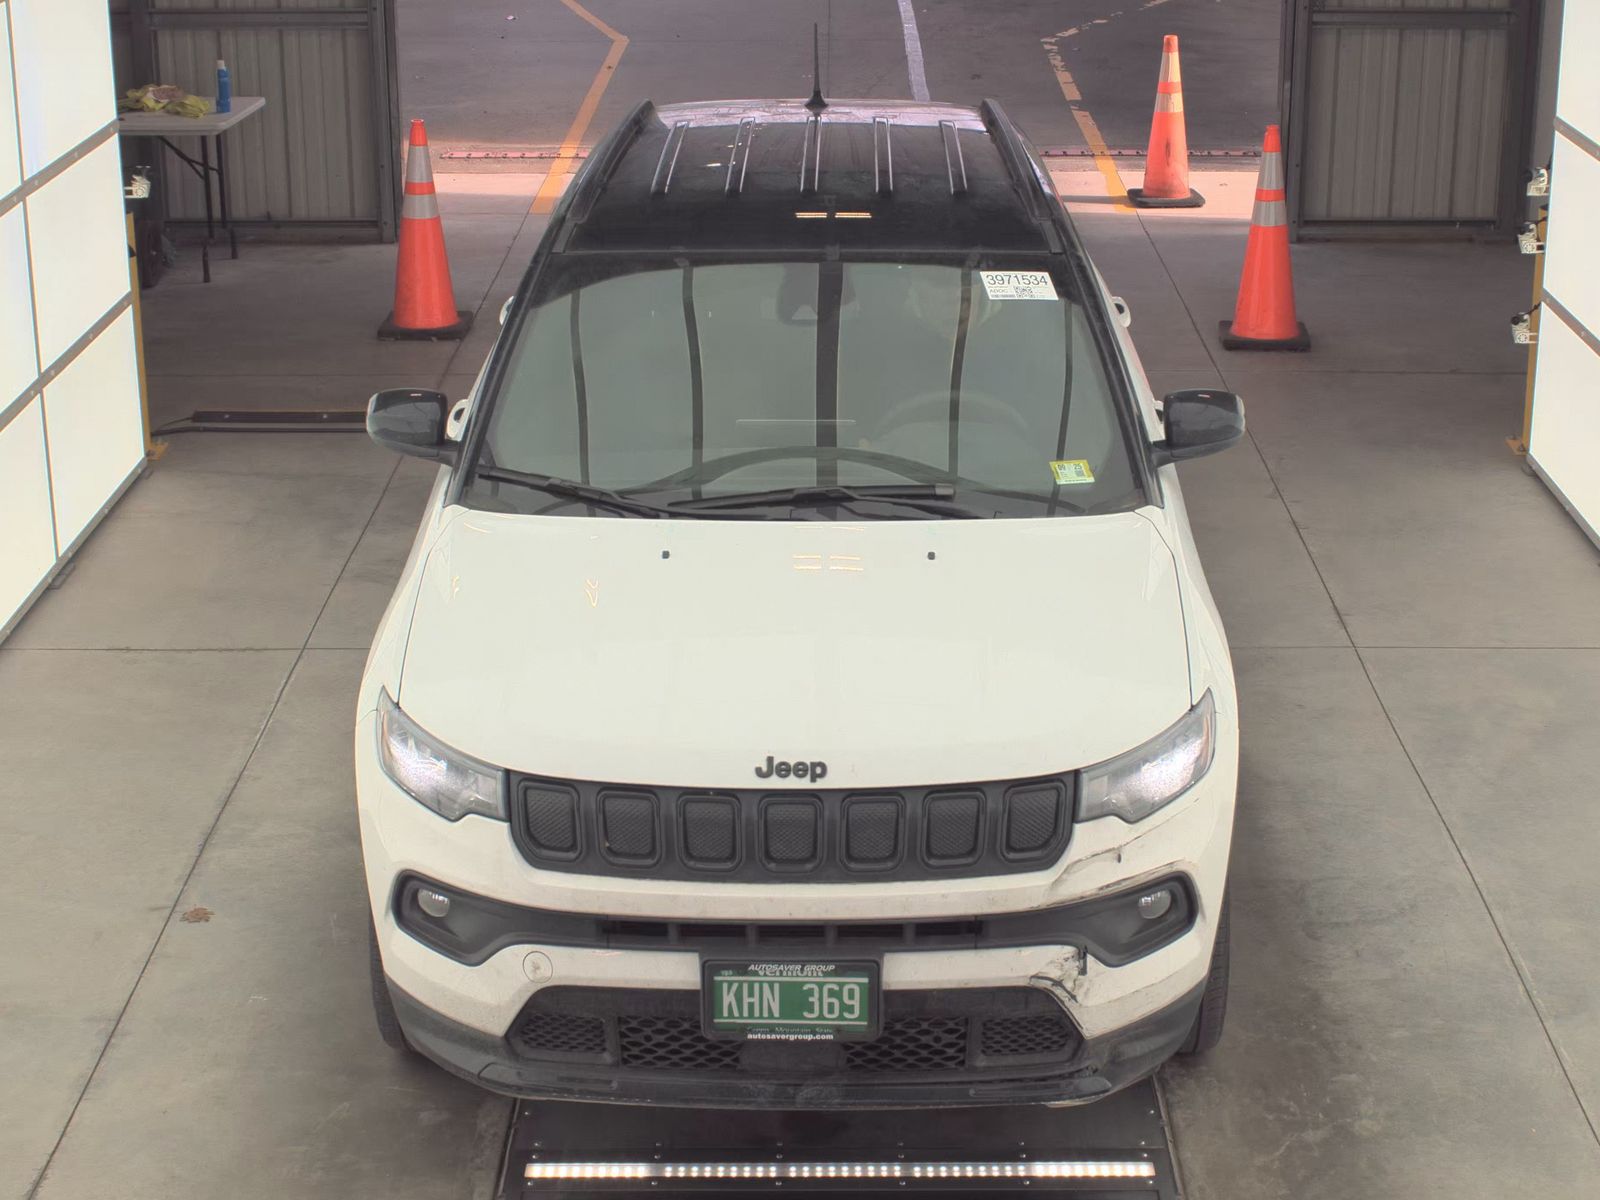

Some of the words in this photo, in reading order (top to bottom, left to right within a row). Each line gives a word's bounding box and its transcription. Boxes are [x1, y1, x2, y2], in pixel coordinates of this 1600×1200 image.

[986, 274, 1048, 285] 3971534
[755, 756, 828, 783] Jeep
[748, 964, 801, 972] AUTOSAVER
[804, 964, 835, 972] GROUP
[722, 982, 780, 1018] KHN
[802, 983, 861, 1019] 369
[747, 1033, 834, 1041] autosavergroup.com
